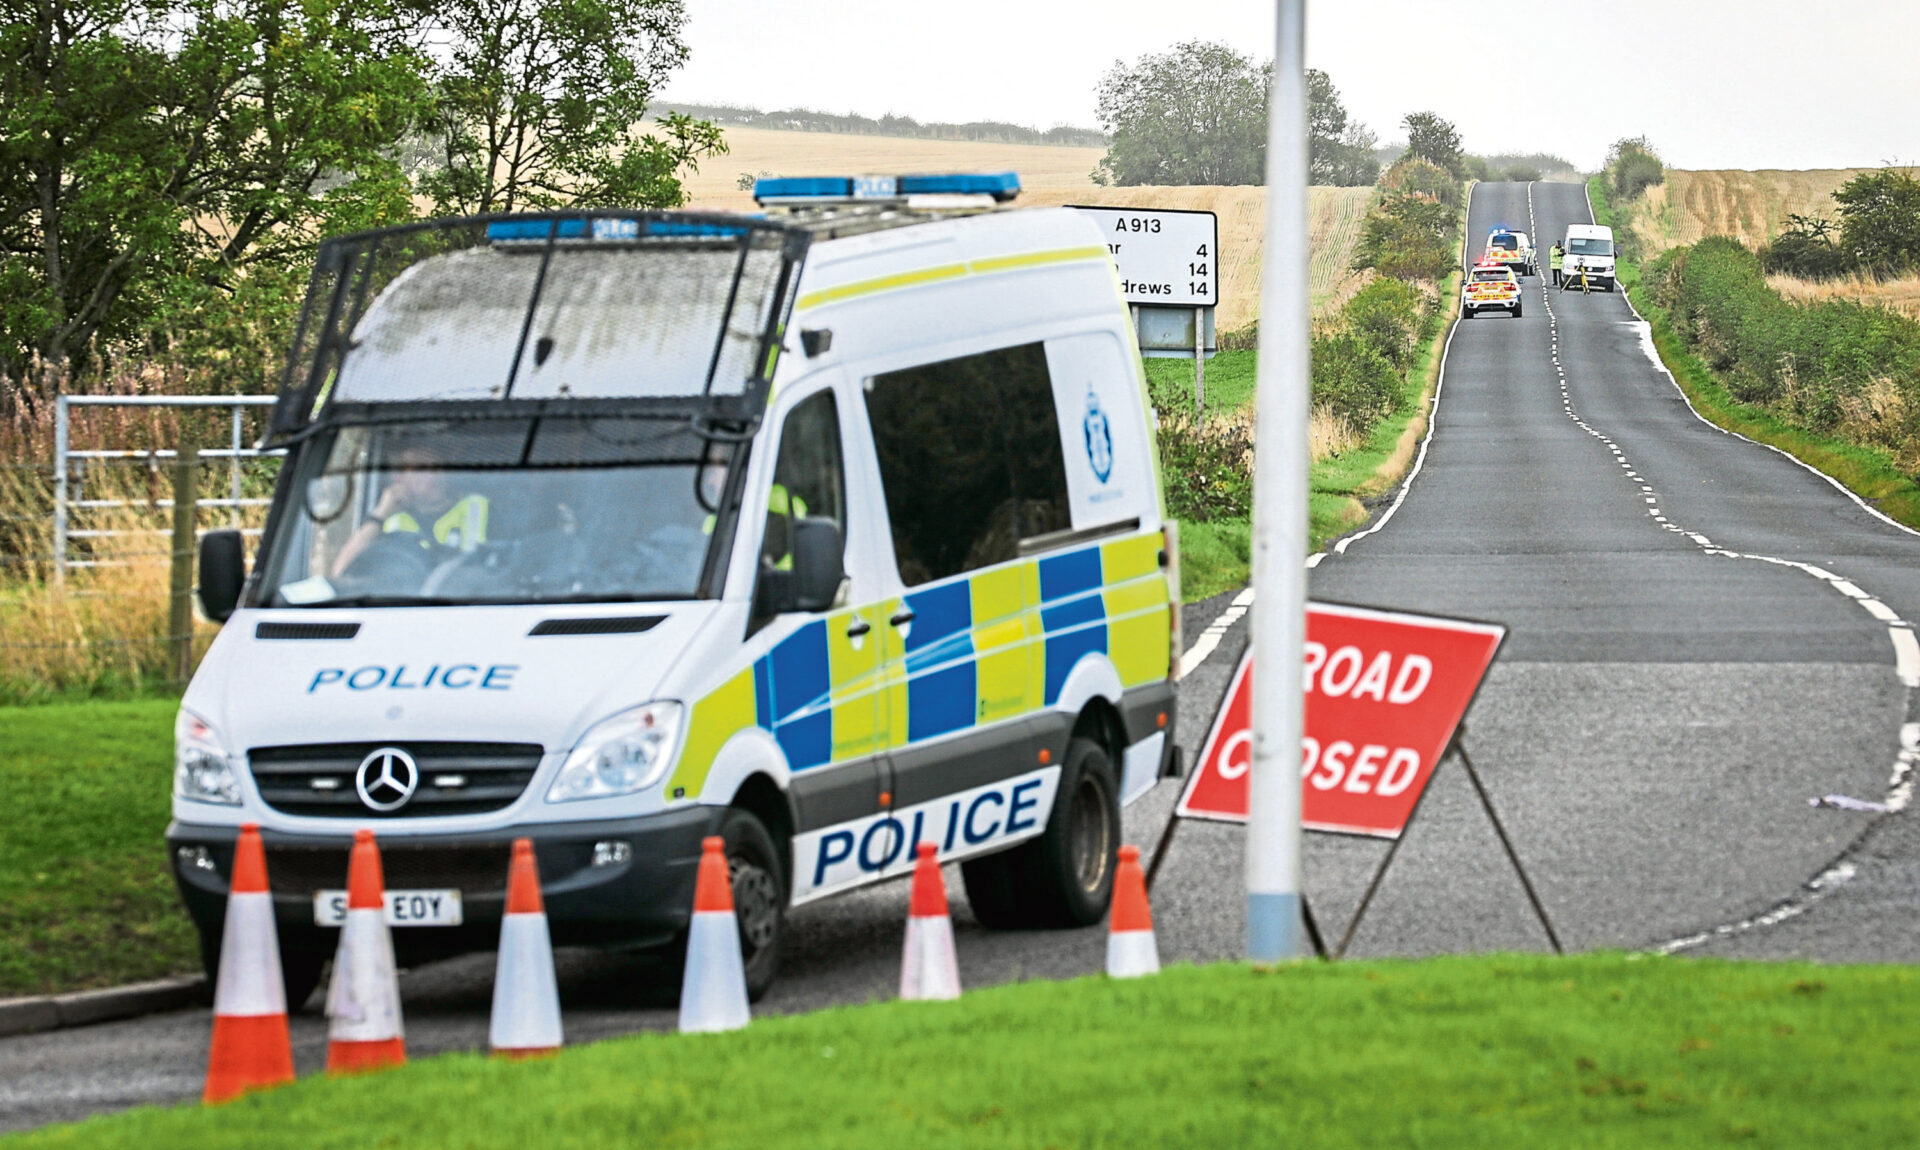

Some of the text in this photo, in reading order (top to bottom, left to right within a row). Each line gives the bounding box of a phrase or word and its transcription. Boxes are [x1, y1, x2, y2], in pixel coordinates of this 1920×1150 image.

[1196, 244, 1208, 257] 4
[1189, 262, 1208, 276] 14
[1189, 281, 1208, 296] 14
[306, 664, 520, 693] POLICE
[813, 779, 1041, 887] POLICE
[394, 896, 441, 920] EOY
